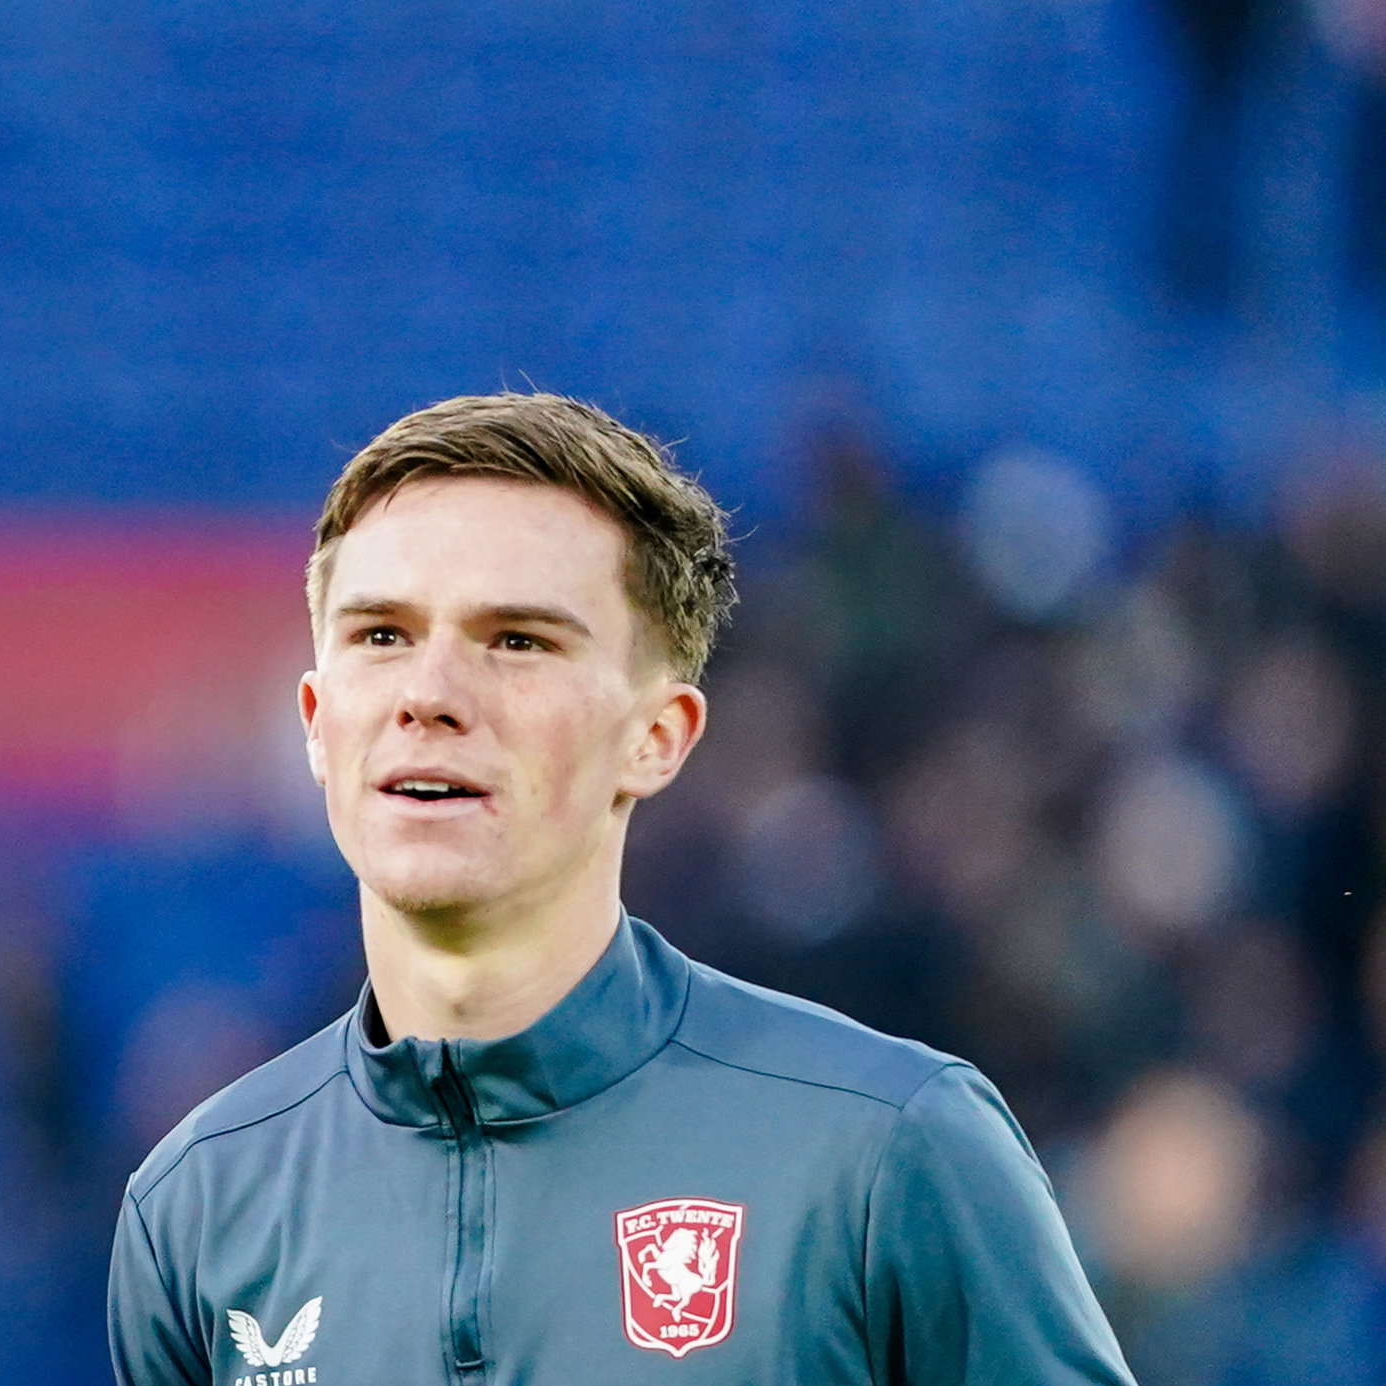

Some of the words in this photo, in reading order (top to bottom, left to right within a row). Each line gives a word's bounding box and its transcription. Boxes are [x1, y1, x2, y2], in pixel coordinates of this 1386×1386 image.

[625, 1214, 656, 1234] F.C.
[657, 1210, 735, 1228] TWENTE
[659, 1323, 700, 1339] 1965
